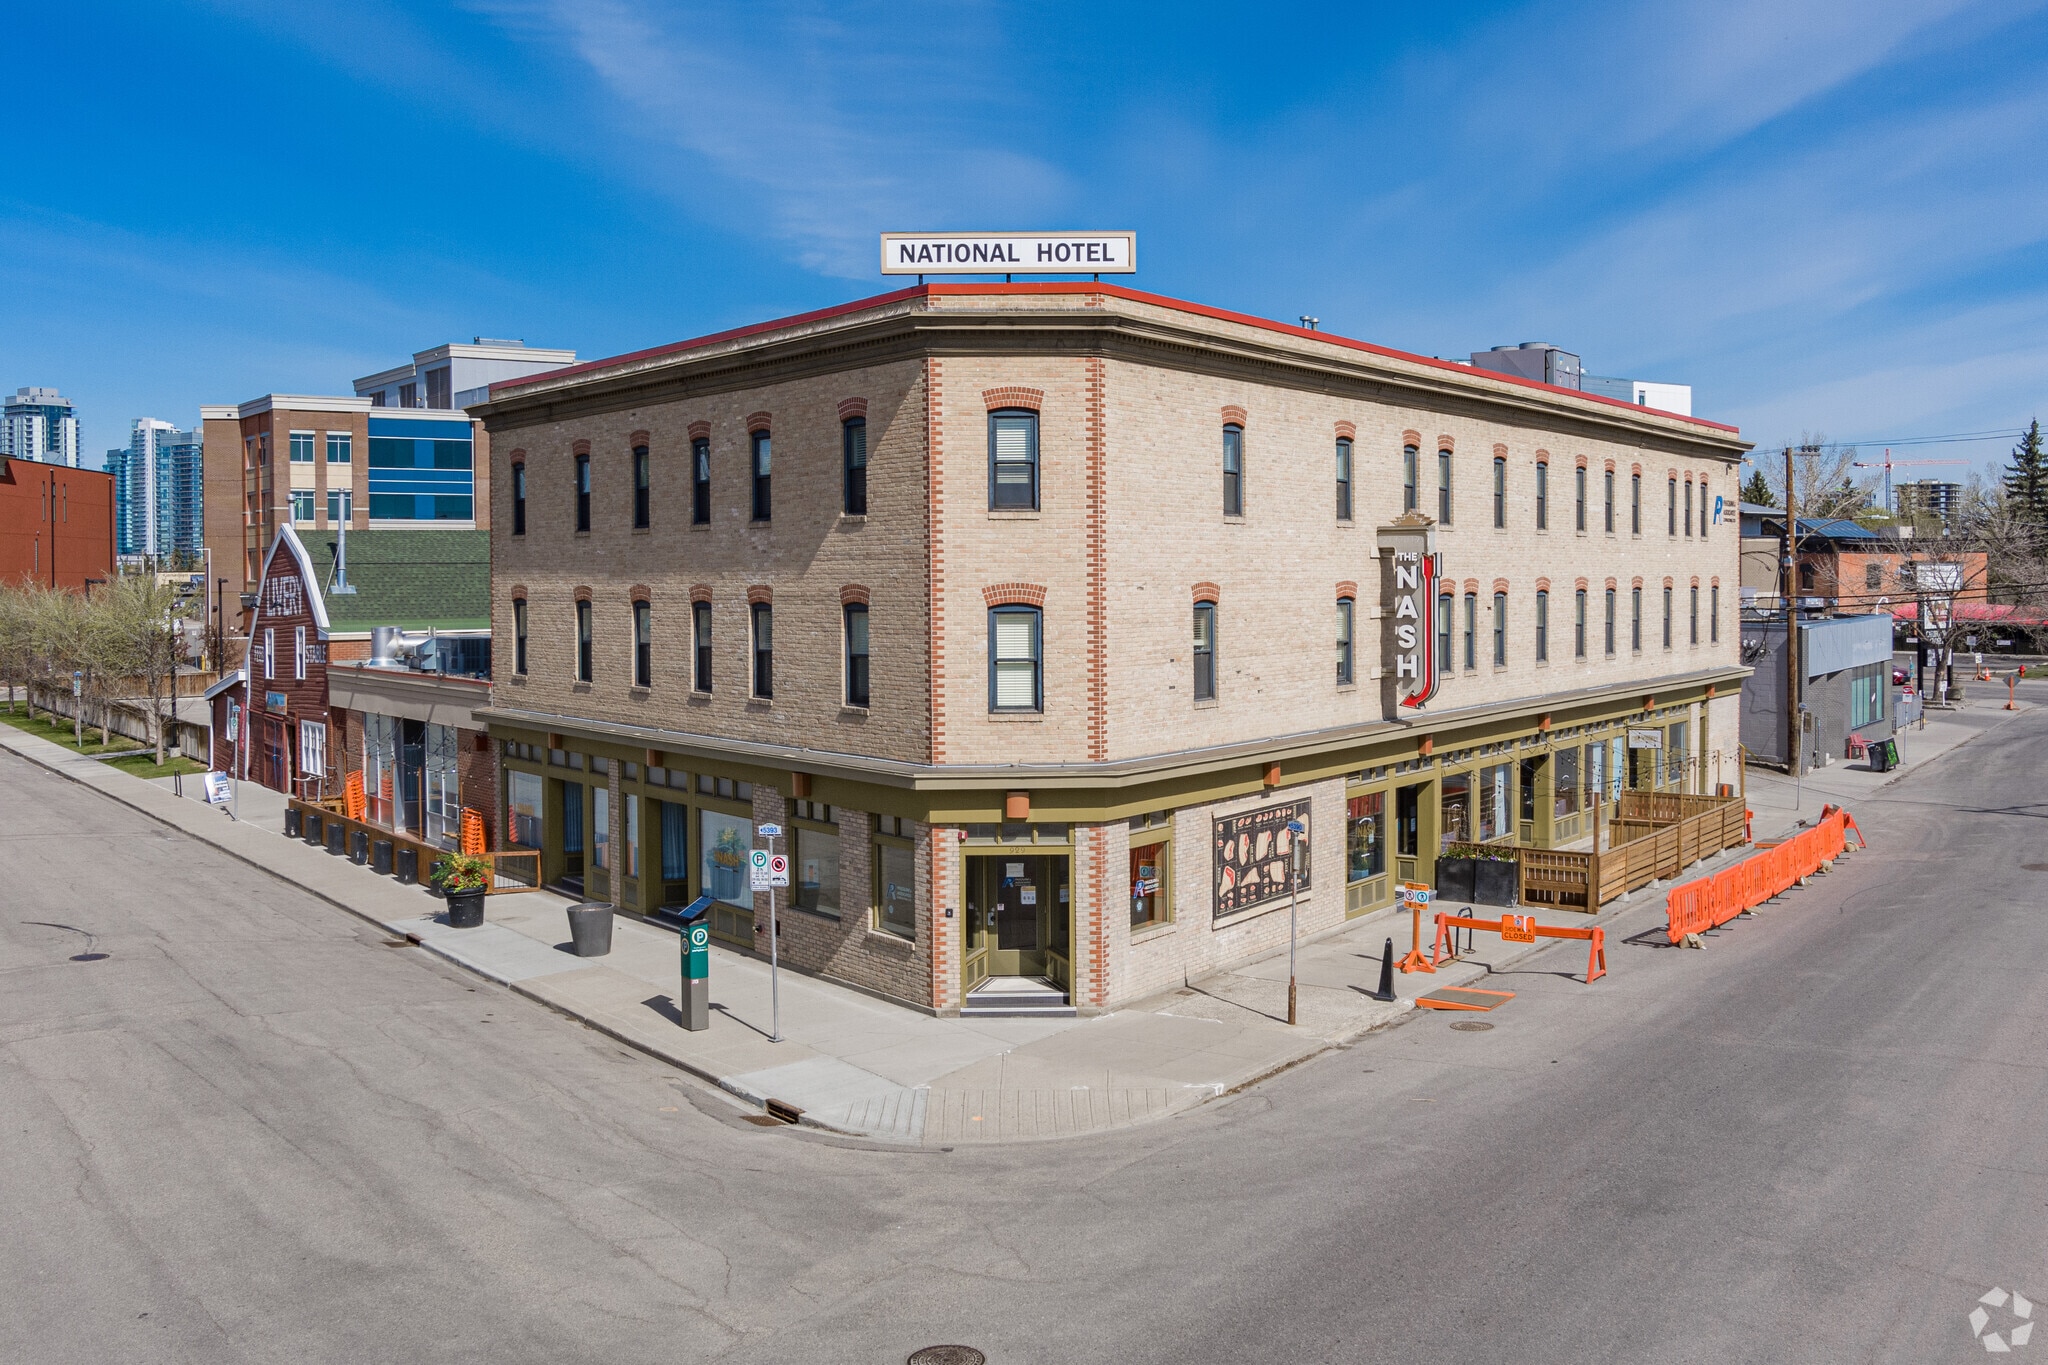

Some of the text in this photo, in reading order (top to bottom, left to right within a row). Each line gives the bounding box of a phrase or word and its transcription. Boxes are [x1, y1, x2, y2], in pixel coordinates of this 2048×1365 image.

[900, 243, 1115, 263] NATIONAL HOTEL
[1398, 552, 1418, 562] THE
[266, 575, 303, 616] LIVERY
[1396, 565, 1419, 679] NASH
[305, 644, 326, 663] STABLE
[1009, 846, 1026, 854] 929
[714, 850, 740, 868] NASH
[756, 855, 764, 865] P
[696, 932, 704, 942] P
[1503, 932, 1533, 941] CLOSED
